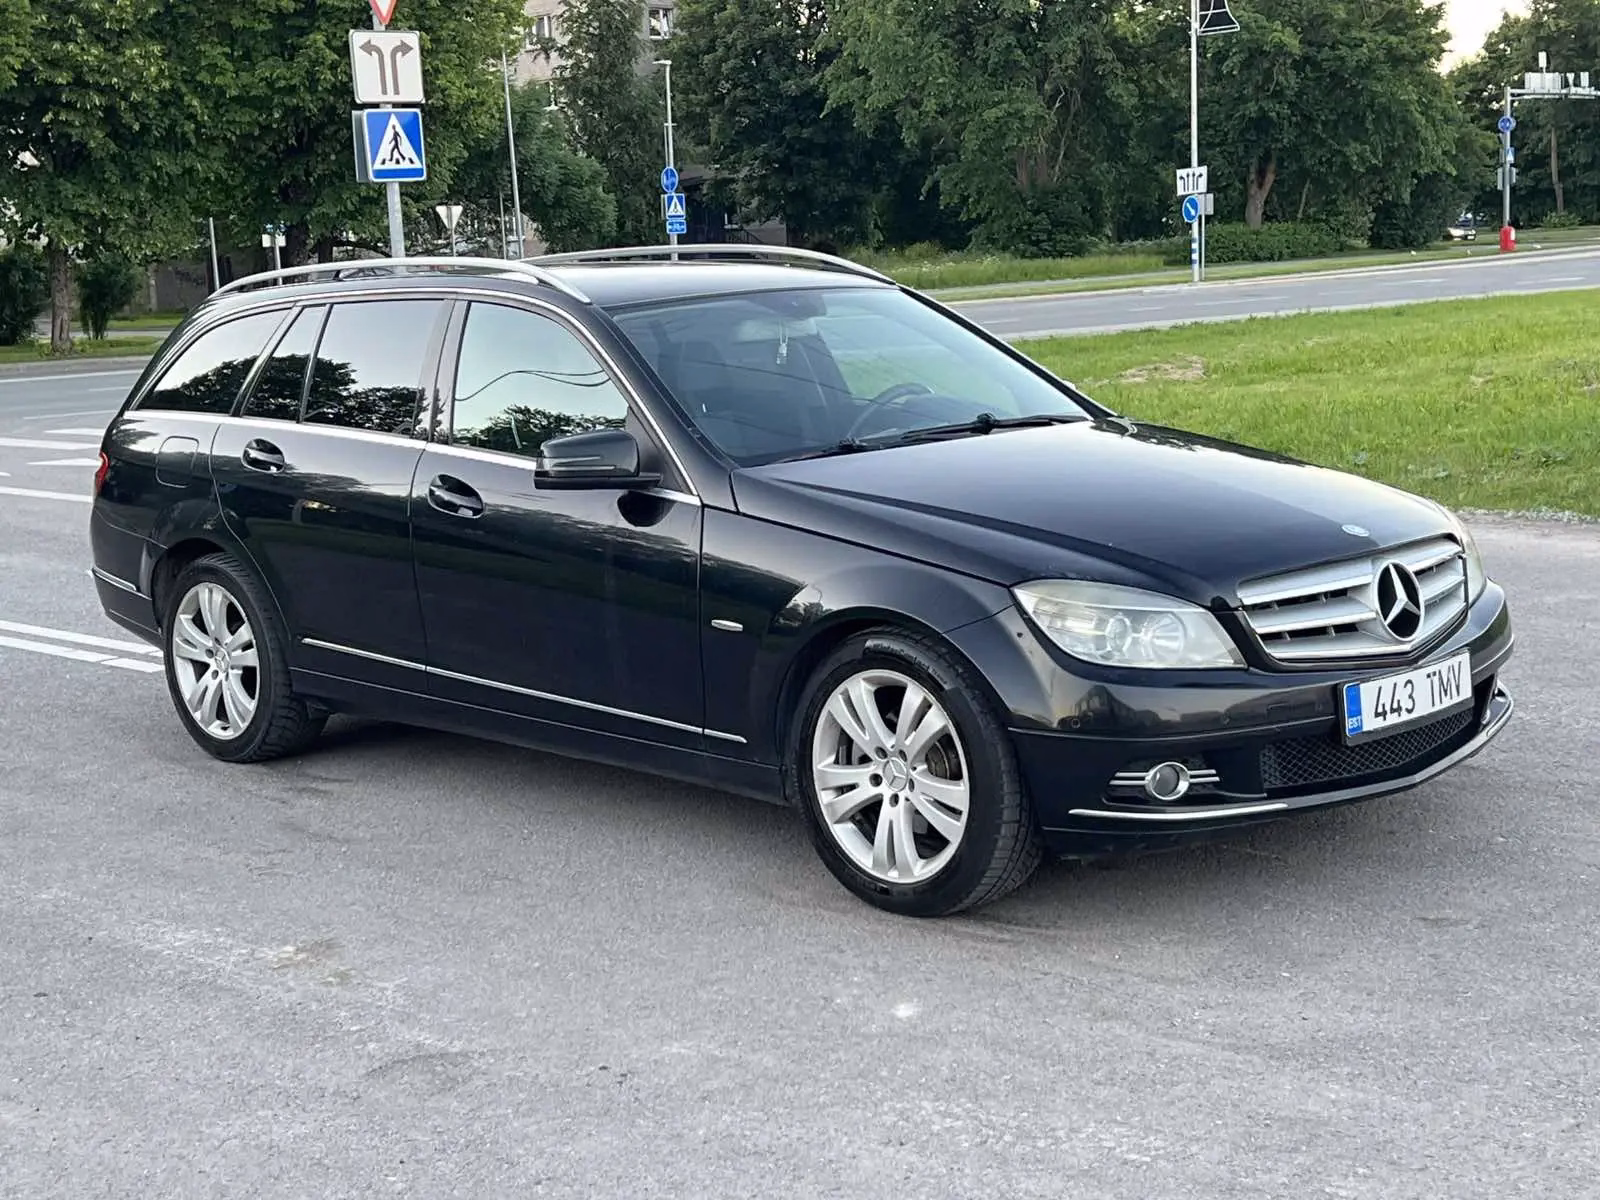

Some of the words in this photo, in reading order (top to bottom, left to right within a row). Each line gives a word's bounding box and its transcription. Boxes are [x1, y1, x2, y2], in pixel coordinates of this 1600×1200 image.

[1374, 679, 1416, 721] 443
[1426, 661, 1462, 707] TMV
[1348, 716, 1362, 729] EST
